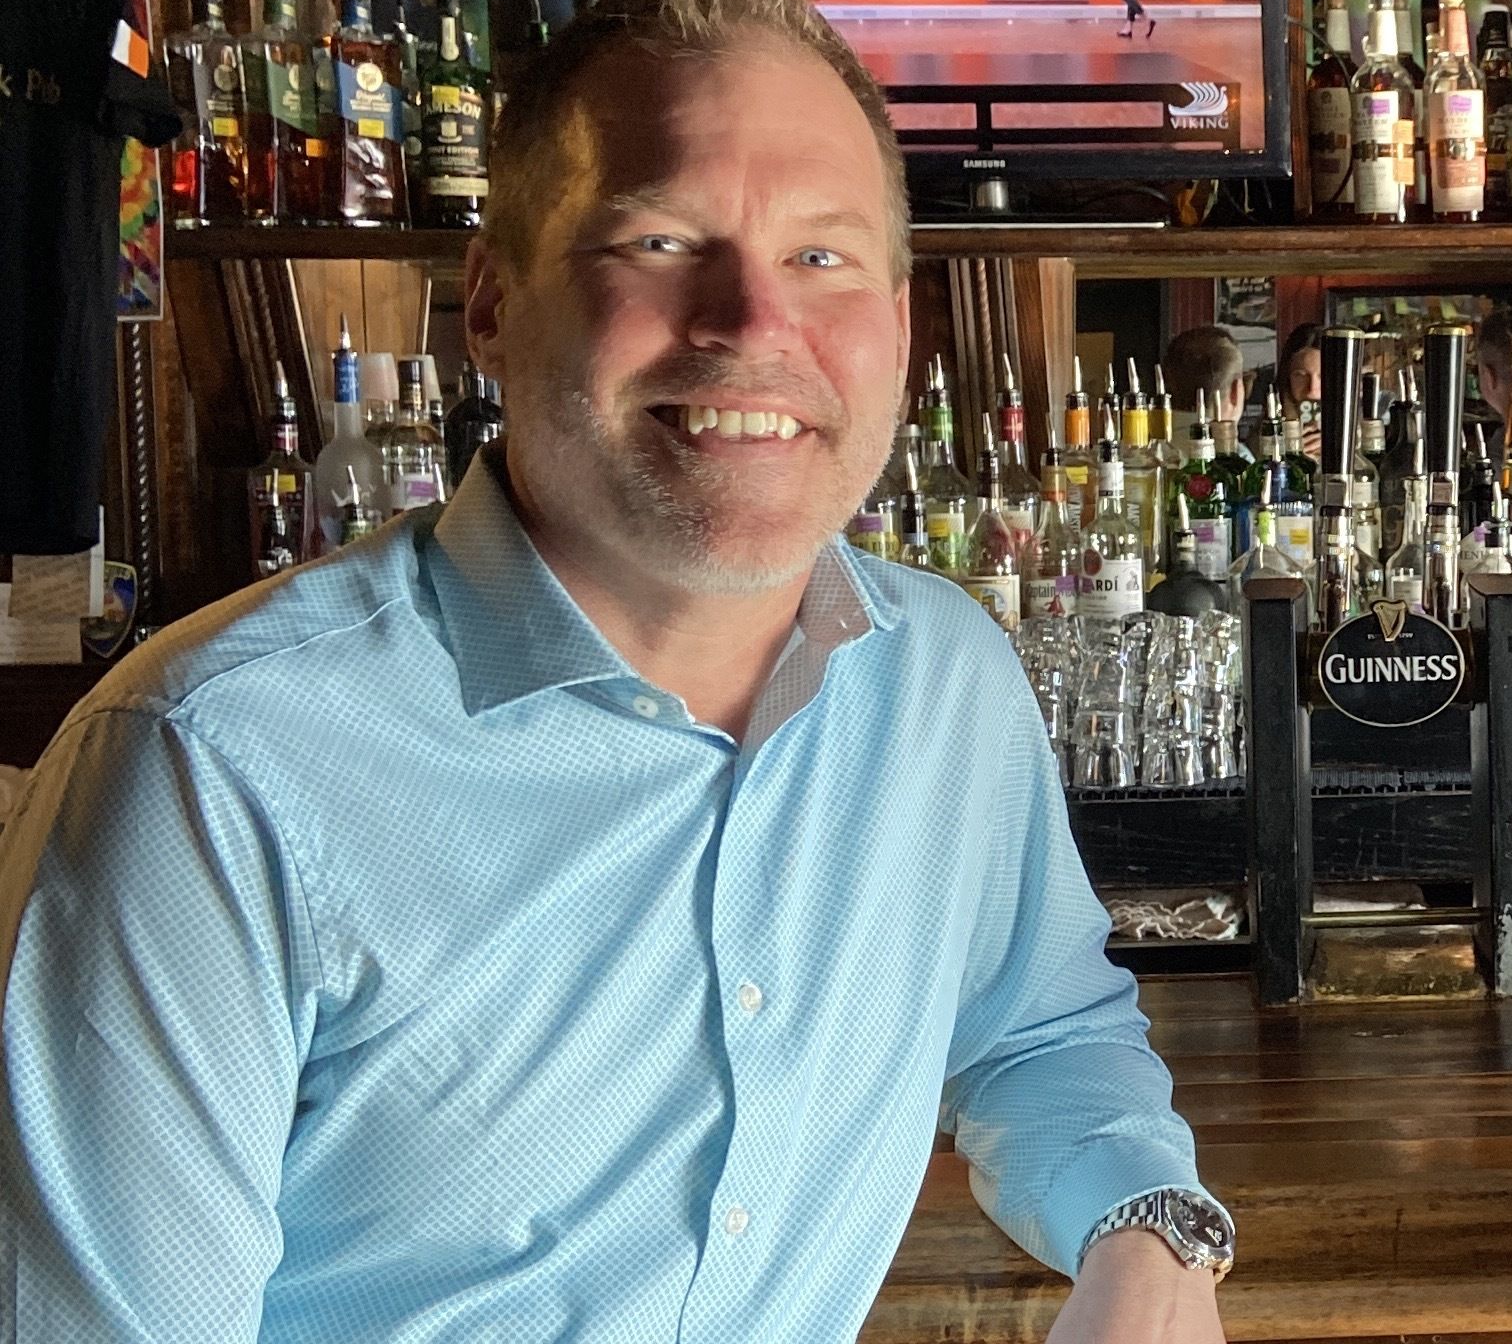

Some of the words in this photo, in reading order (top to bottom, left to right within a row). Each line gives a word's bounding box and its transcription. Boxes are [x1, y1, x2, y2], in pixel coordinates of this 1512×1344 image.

[1170, 117, 1229, 129] VIKING
[963, 159, 1006, 169] SAMSUNG
[1324, 653, 1459, 684] GUINNESS
